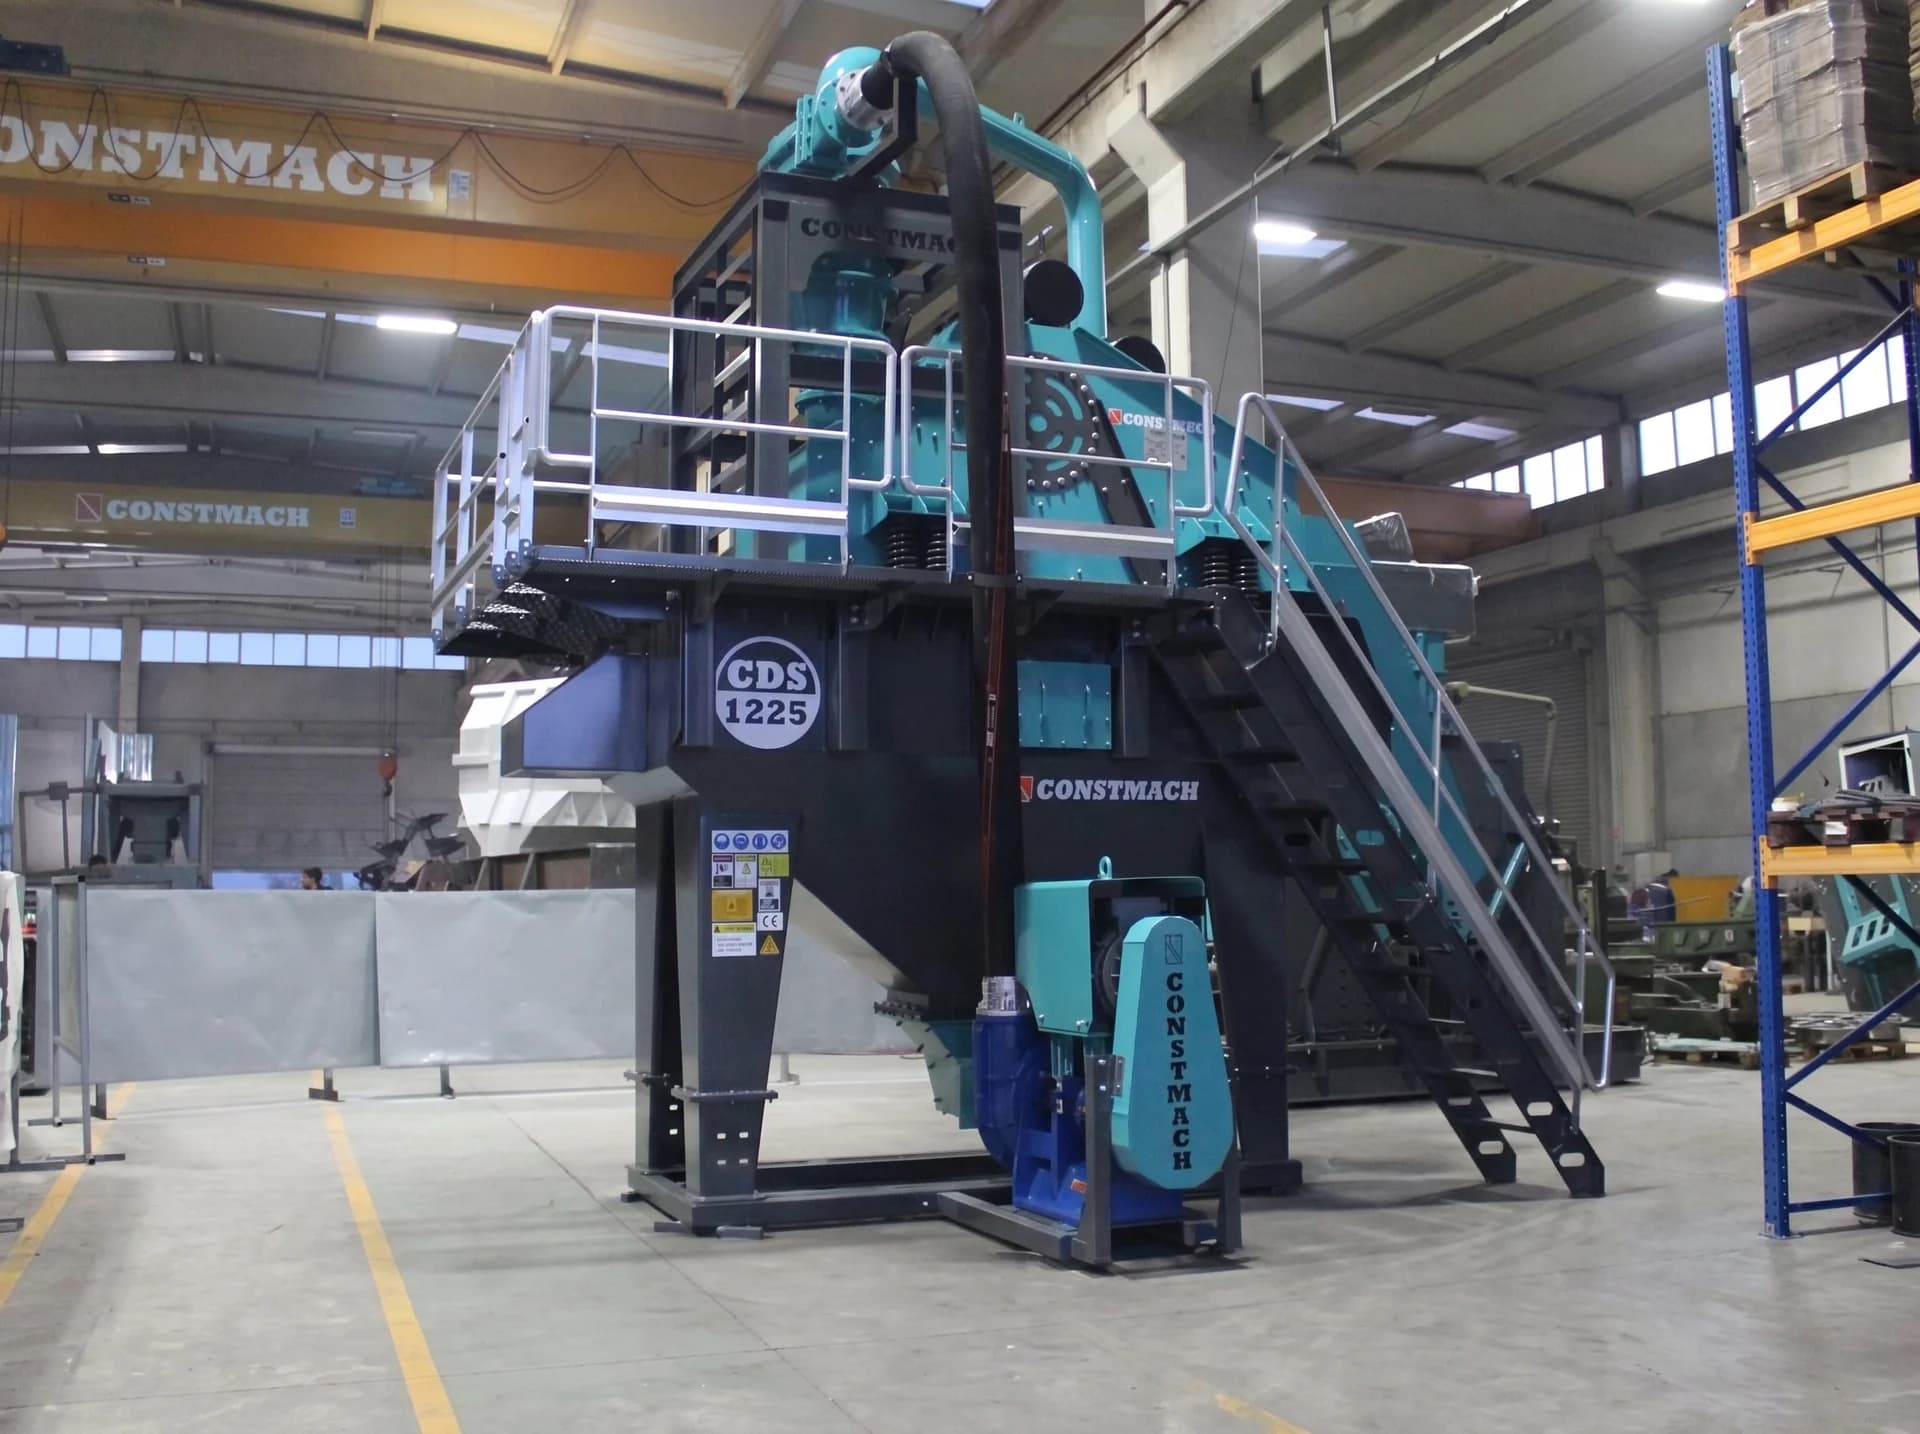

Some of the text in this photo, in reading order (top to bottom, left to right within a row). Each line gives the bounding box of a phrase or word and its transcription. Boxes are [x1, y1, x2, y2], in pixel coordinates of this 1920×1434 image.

[0, 115, 434, 201] ONSTMACH
[801, 216, 956, 253] CONSTMA
[106, 499, 310, 528] CONSTMACH
[727, 659, 808, 691] CDS
[726, 698, 808, 726] 1225
[1036, 778, 1200, 801] CONSTMACH
[762, 914, 778, 928] CE
[1165, 972, 1193, 1171] CONSTMACH
